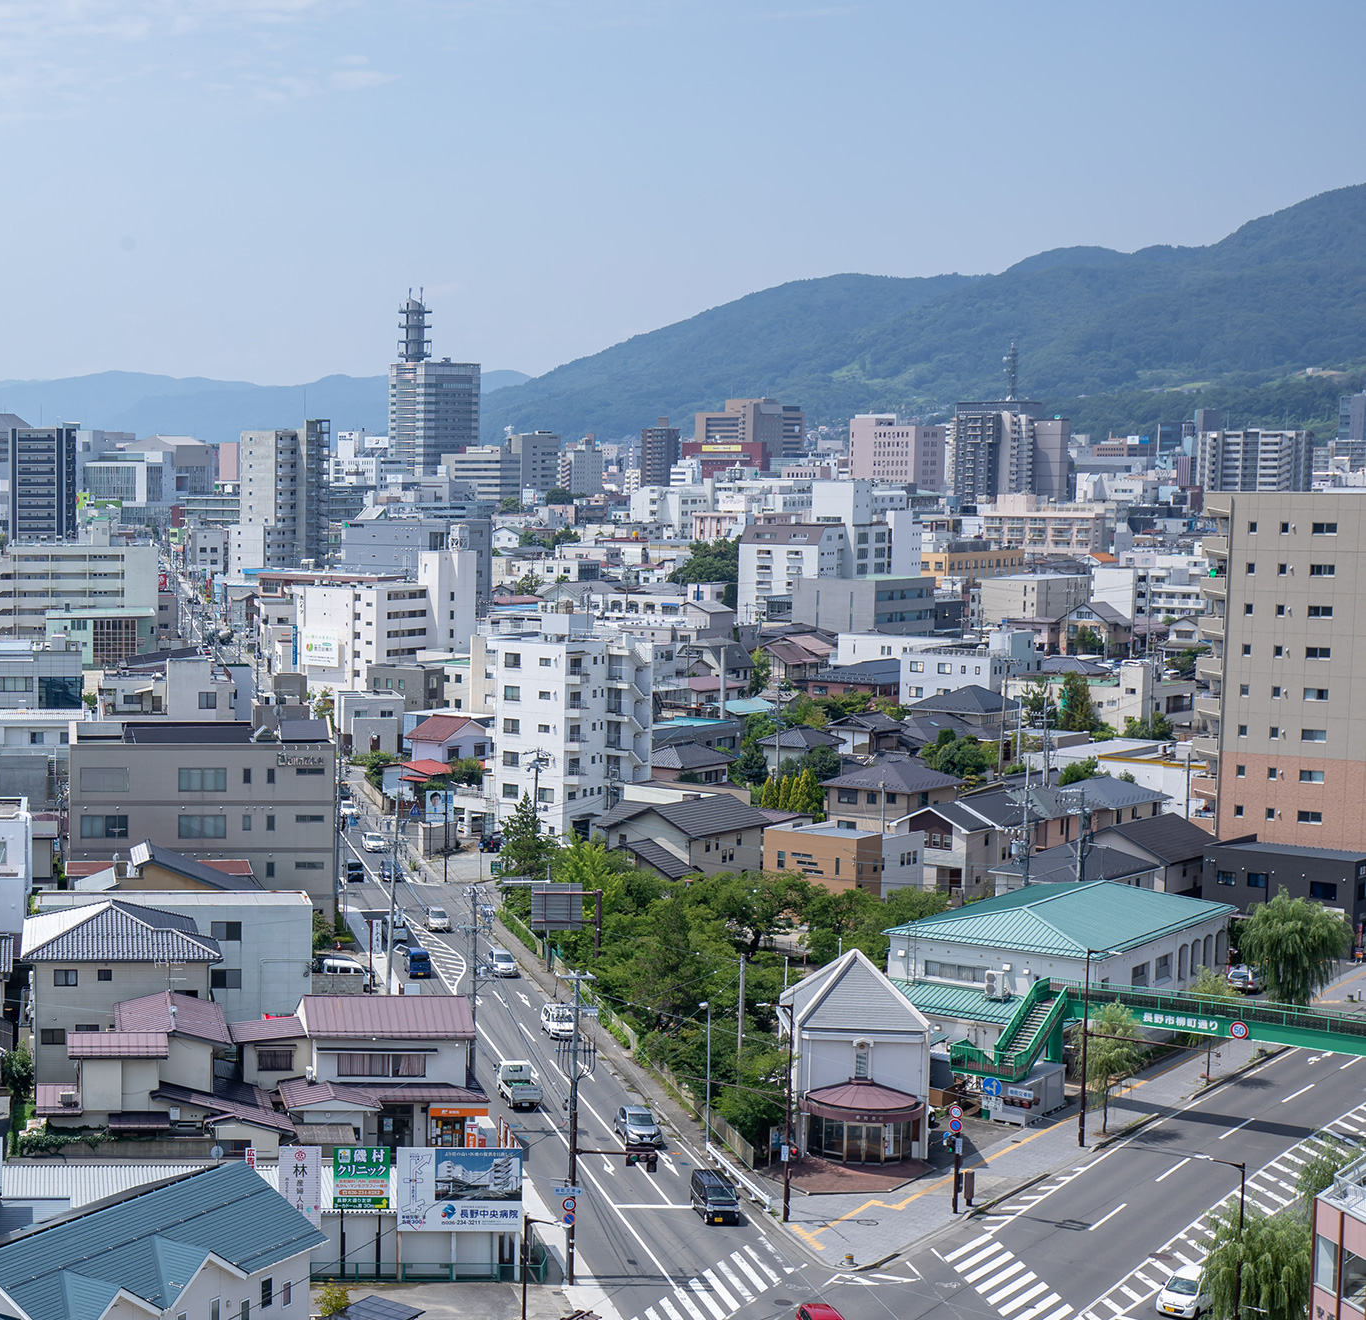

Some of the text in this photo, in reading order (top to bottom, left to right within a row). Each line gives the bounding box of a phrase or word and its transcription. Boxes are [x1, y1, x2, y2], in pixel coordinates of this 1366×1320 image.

[1142, 1012, 1218, 1031] 長野市柳町通り
[247, 1149, 255, 1169] 広告
[353, 1149, 386, 1163] 磯村
[336, 1164, 387, 1177] クリニック
[460, 1209, 519, 1219] 長野中央病院
